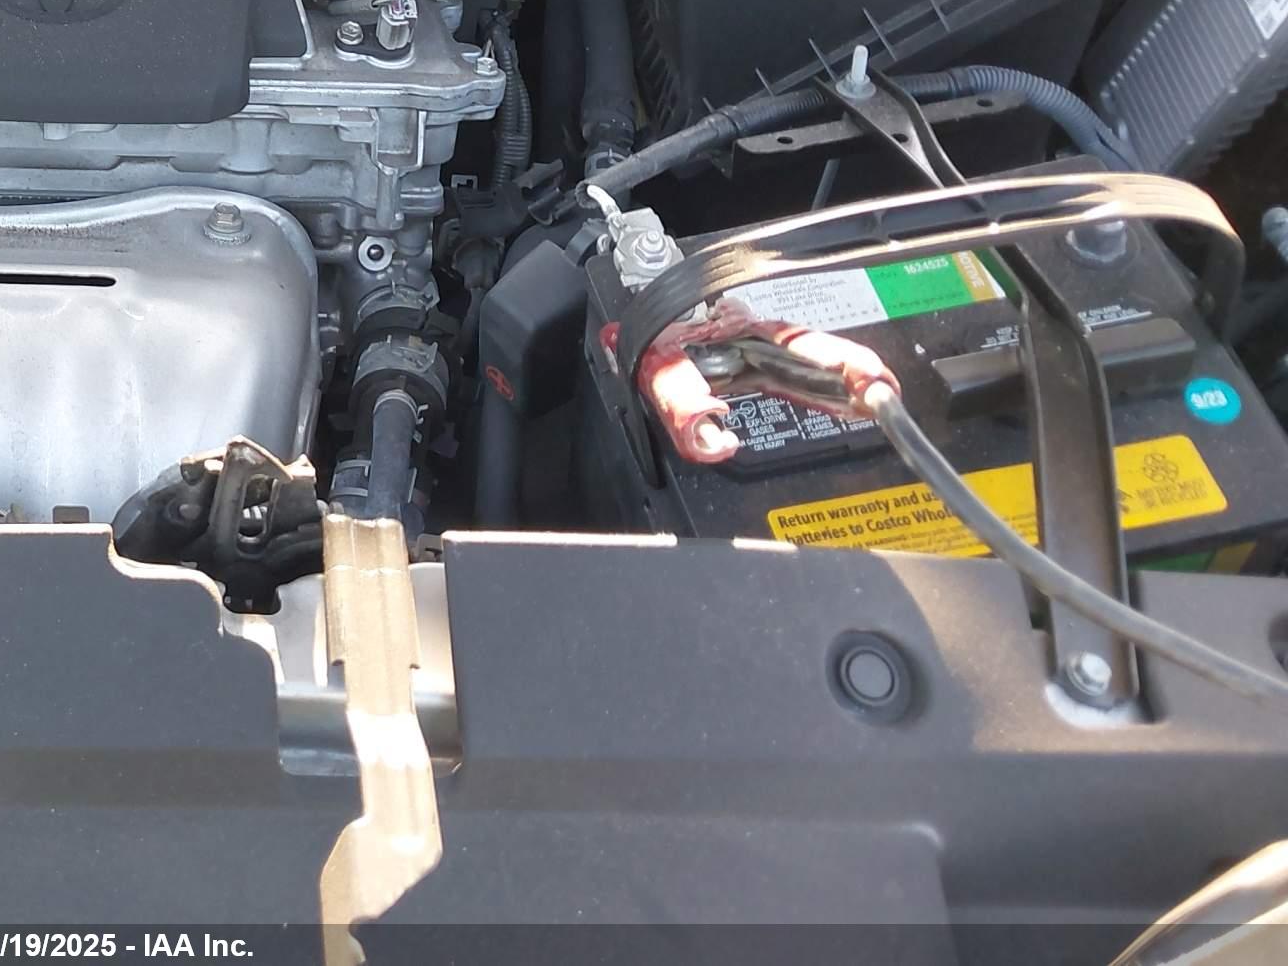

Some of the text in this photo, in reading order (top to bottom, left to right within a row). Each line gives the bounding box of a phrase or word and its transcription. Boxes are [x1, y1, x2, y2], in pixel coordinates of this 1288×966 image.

[760, 405, 782, 418] EYES
[745, 412, 788, 429] EXPLOSIVE
[748, 424, 775, 437] GASES
[777, 490, 939, 529] Return warranty and us
[785, 525, 848, 546] batteries
[848, 522, 863, 536] to
[865, 515, 912, 532] Costco
[911, 507, 953, 524] Whol
